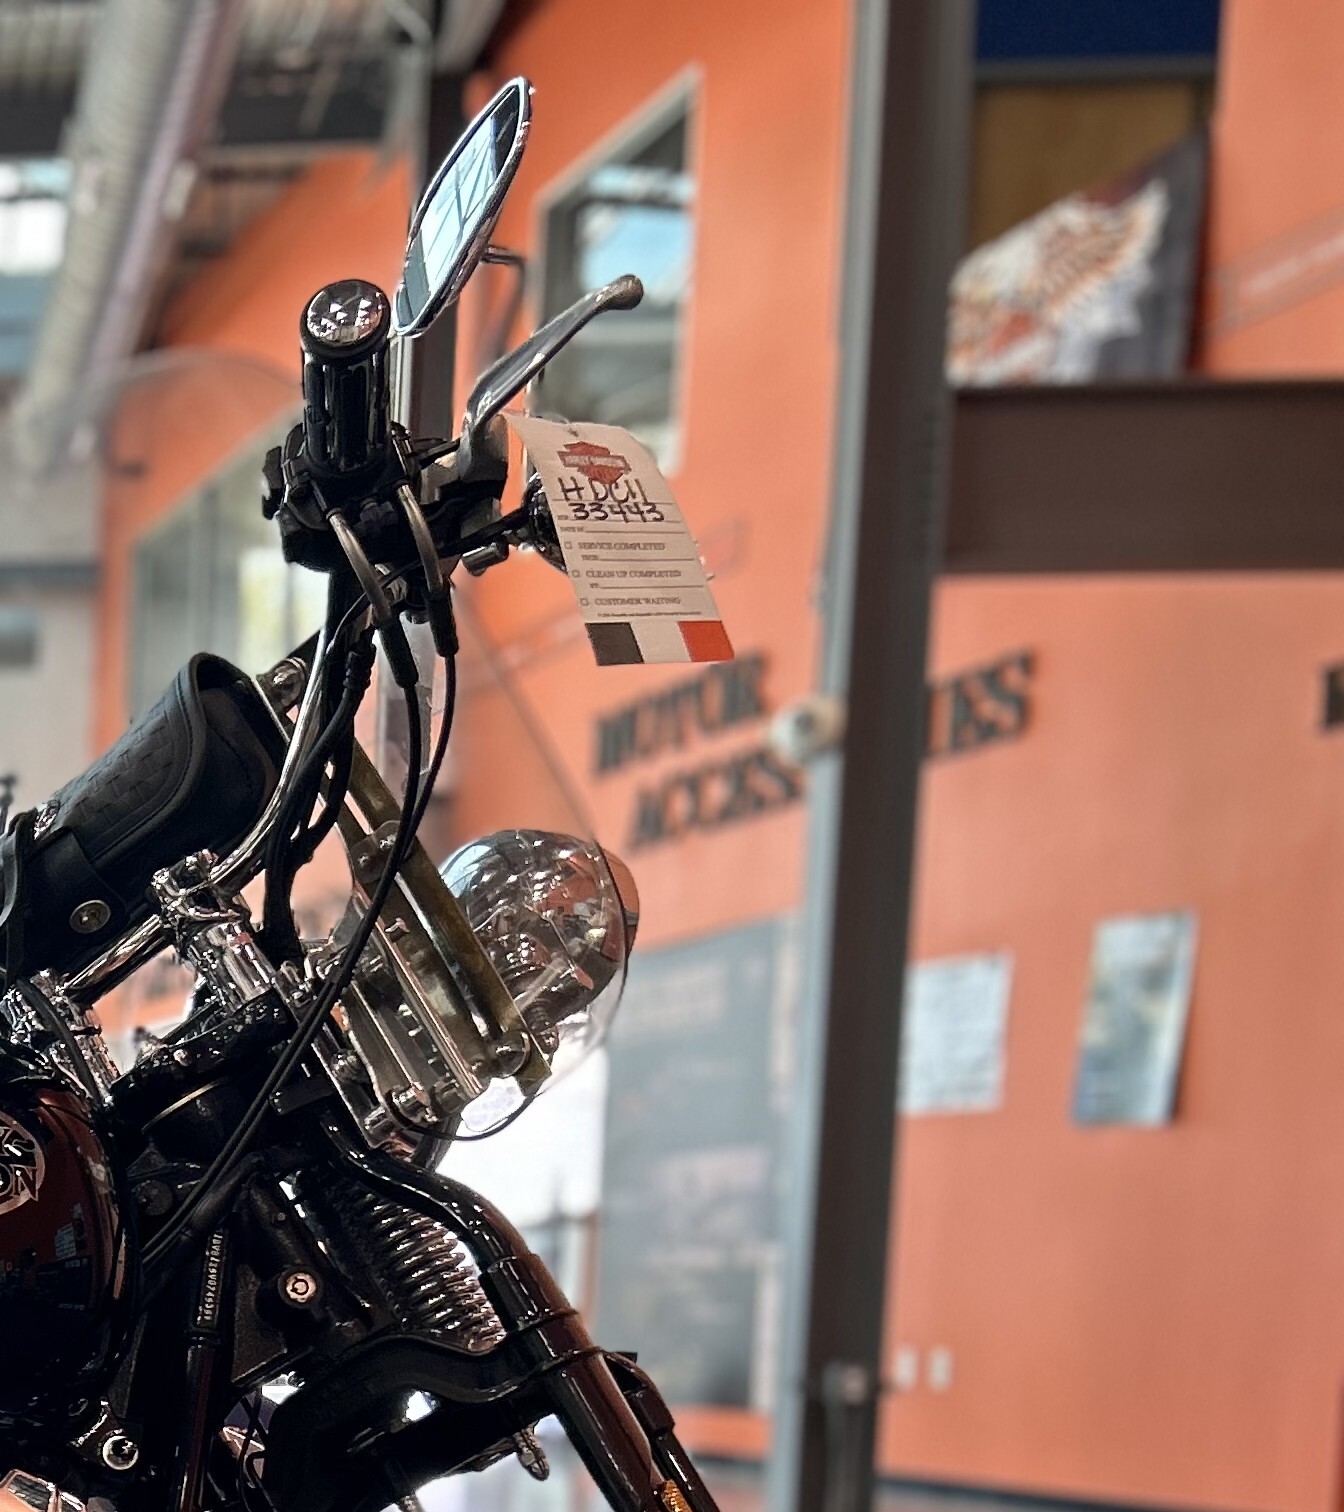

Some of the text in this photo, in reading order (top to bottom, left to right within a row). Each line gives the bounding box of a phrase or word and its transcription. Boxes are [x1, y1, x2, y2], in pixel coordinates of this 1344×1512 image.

[569, 501, 665, 523] 33443
[614, 542, 666, 551] COMPLETED
[586, 570, 615, 578] CLEAN
[629, 569, 682, 578] COMPLETED
